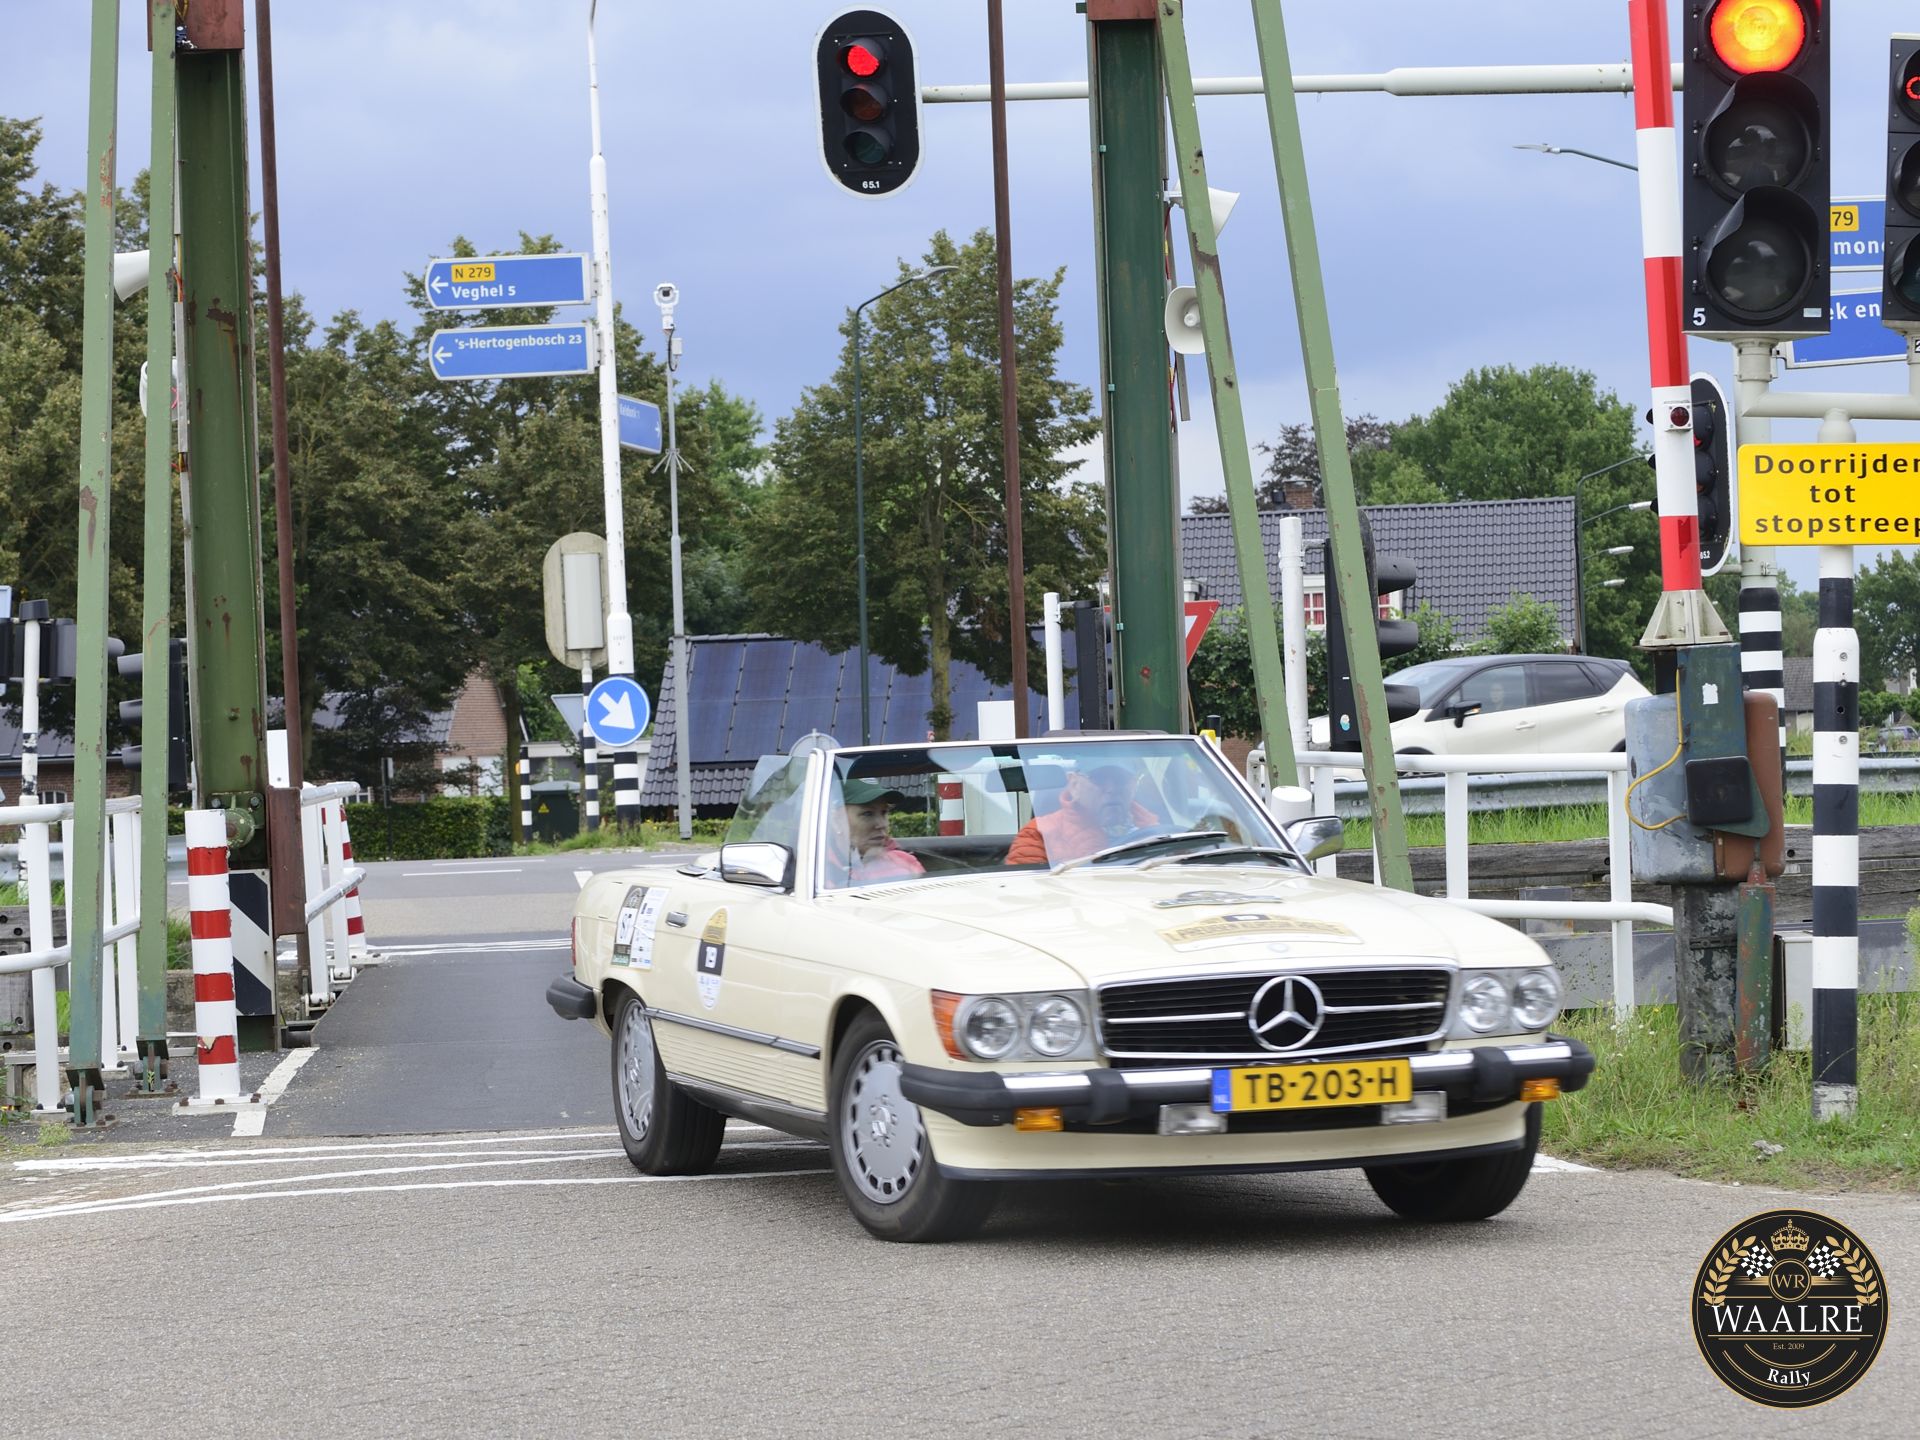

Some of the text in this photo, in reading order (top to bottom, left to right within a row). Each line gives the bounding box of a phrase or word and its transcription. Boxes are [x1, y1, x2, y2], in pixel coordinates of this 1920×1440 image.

[862, 180, 880, 189] 65.1
[1831, 210, 1854, 227] 79
[1833, 239, 1885, 256] mon
[455, 266, 491, 279] N 279
[451, 283, 516, 301] Veghel 5
[1692, 308, 1706, 327] 5
[1855, 302, 1881, 319] en
[454, 333, 582, 351] 's-Hertogenbosch 23
[1809, 485, 1856, 503] tot
[1244, 1066, 1398, 1104] TB-203-H
